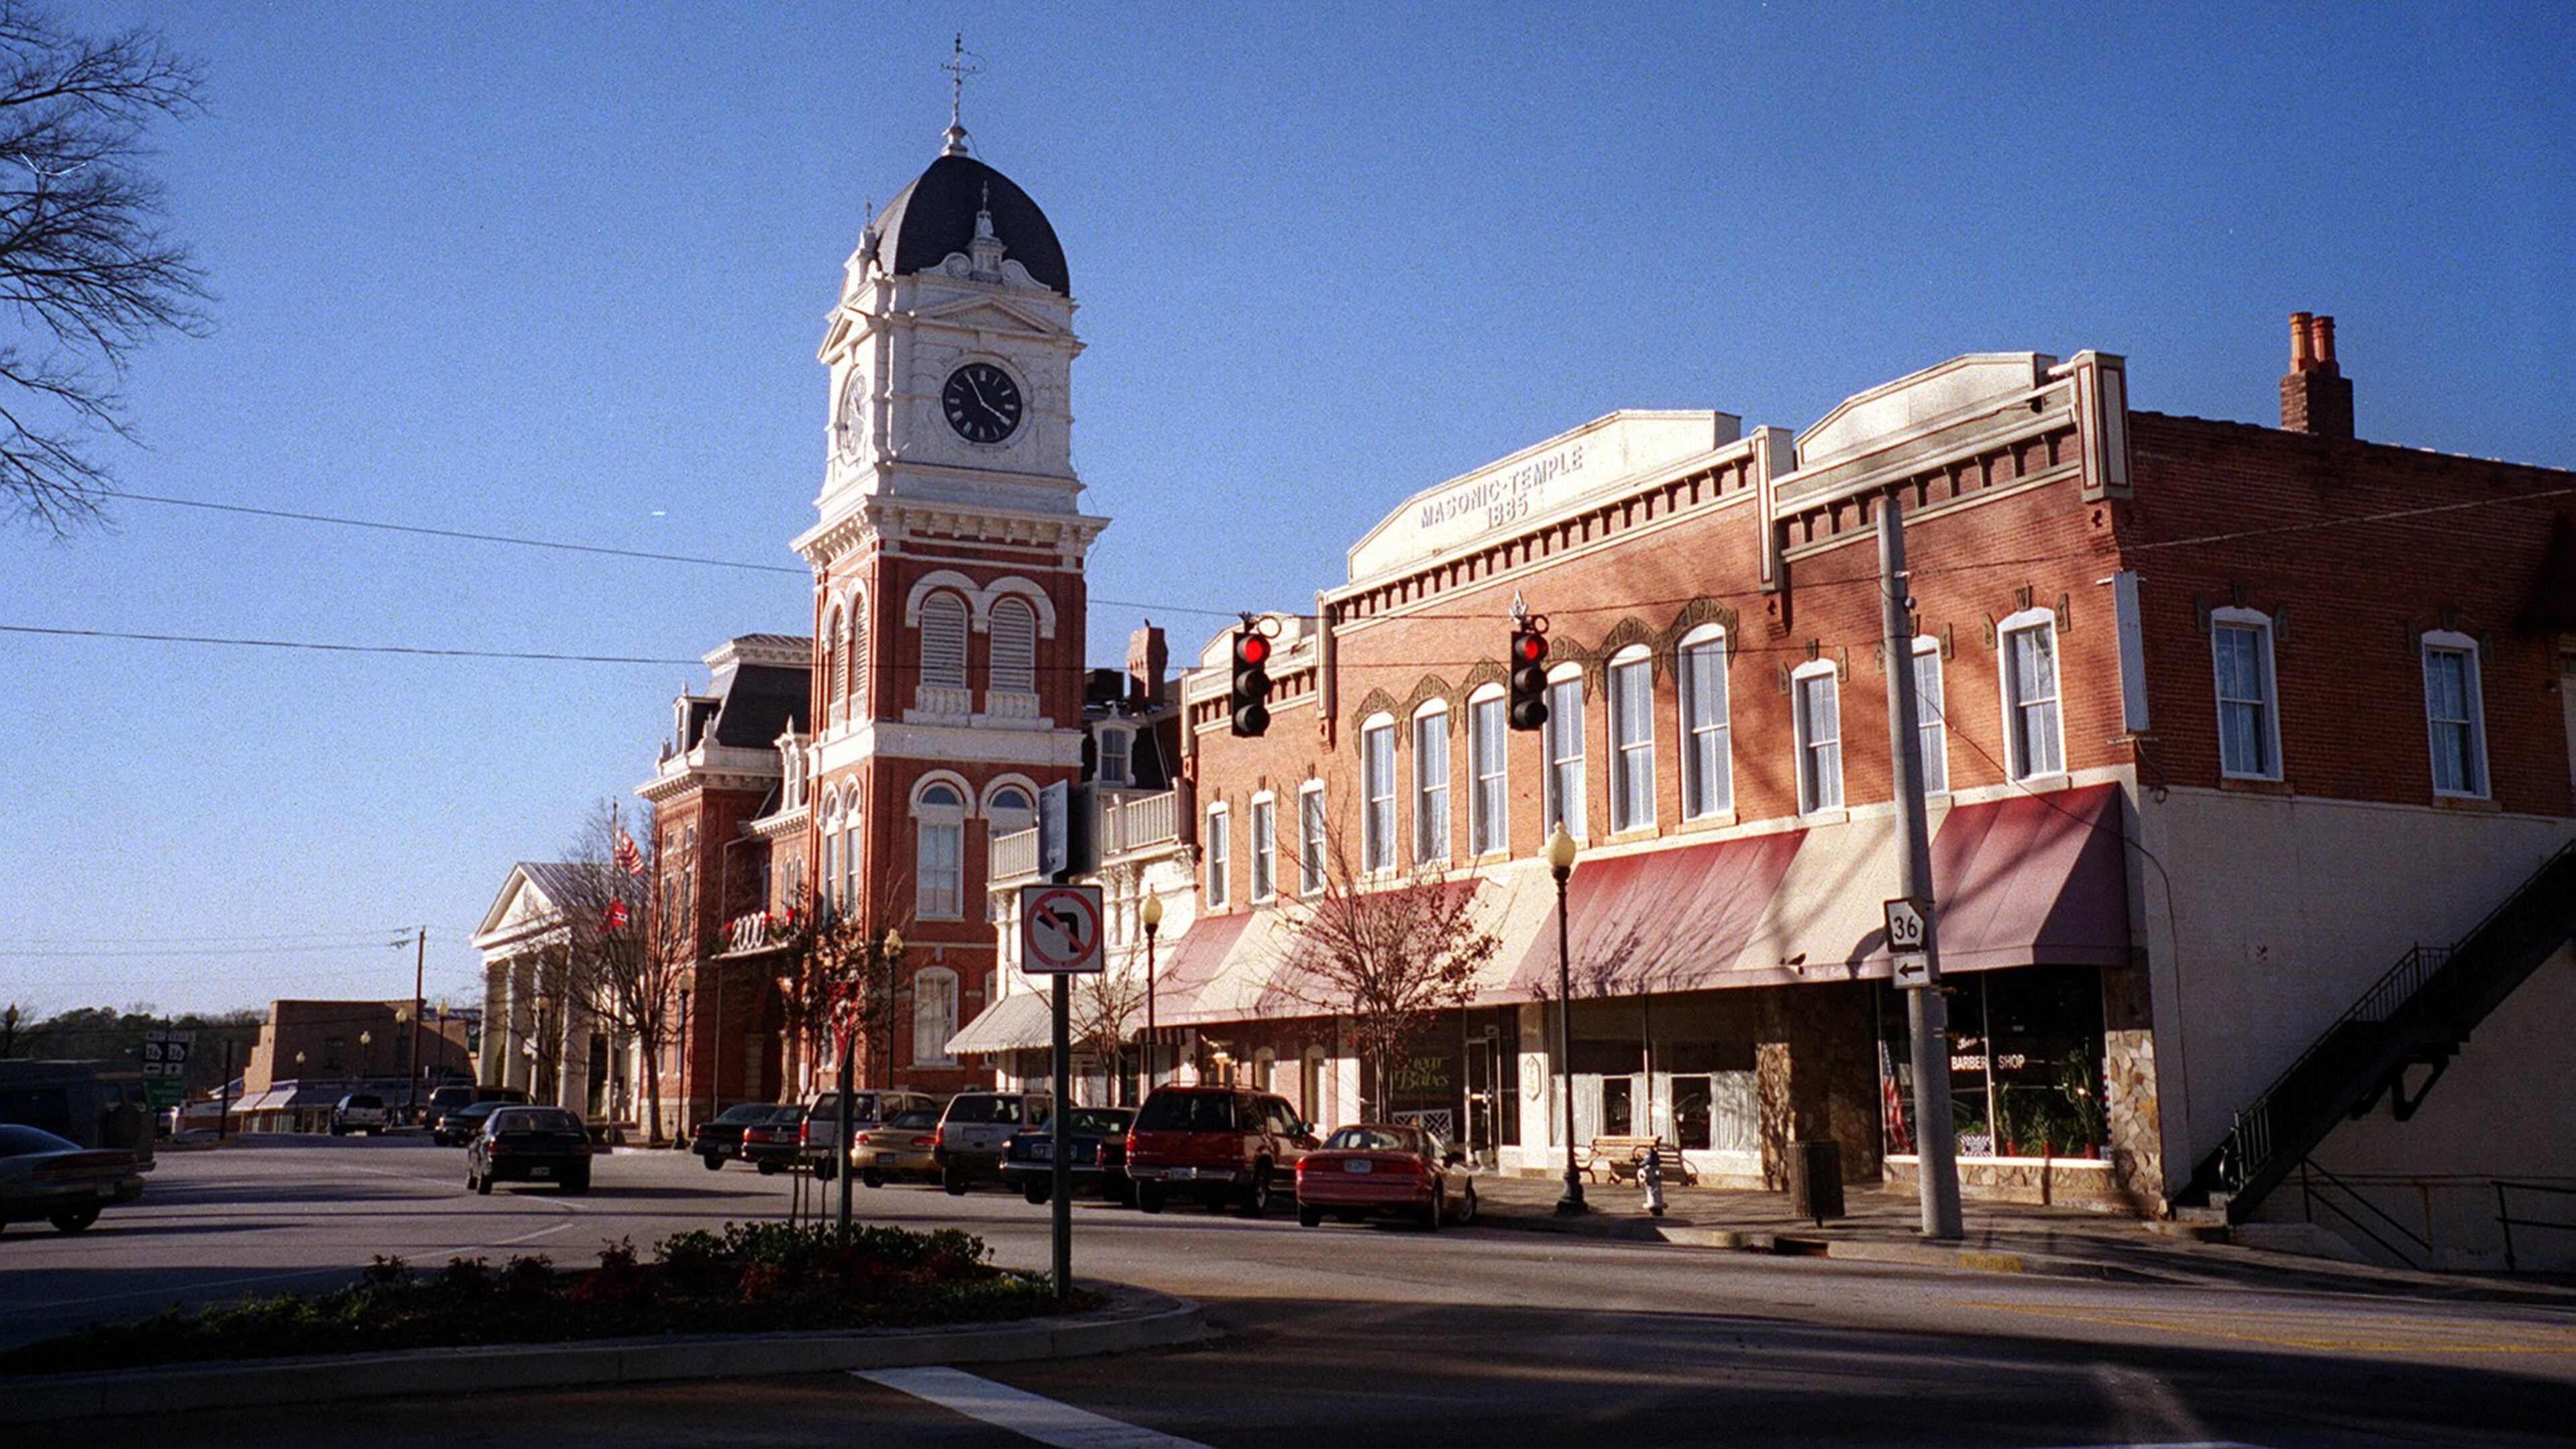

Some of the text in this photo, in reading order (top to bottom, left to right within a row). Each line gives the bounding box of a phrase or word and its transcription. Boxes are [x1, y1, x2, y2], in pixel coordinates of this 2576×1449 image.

[1487, 492, 1529, 530] 1885
[729, 910, 766, 953] 2000
[1893, 915, 1918, 940] 36
[1403, 1053, 1452, 1073] ugar
[1951, 1053, 2026, 1071] BARBER SHOP
[1394, 1067, 1450, 1090] Babes
